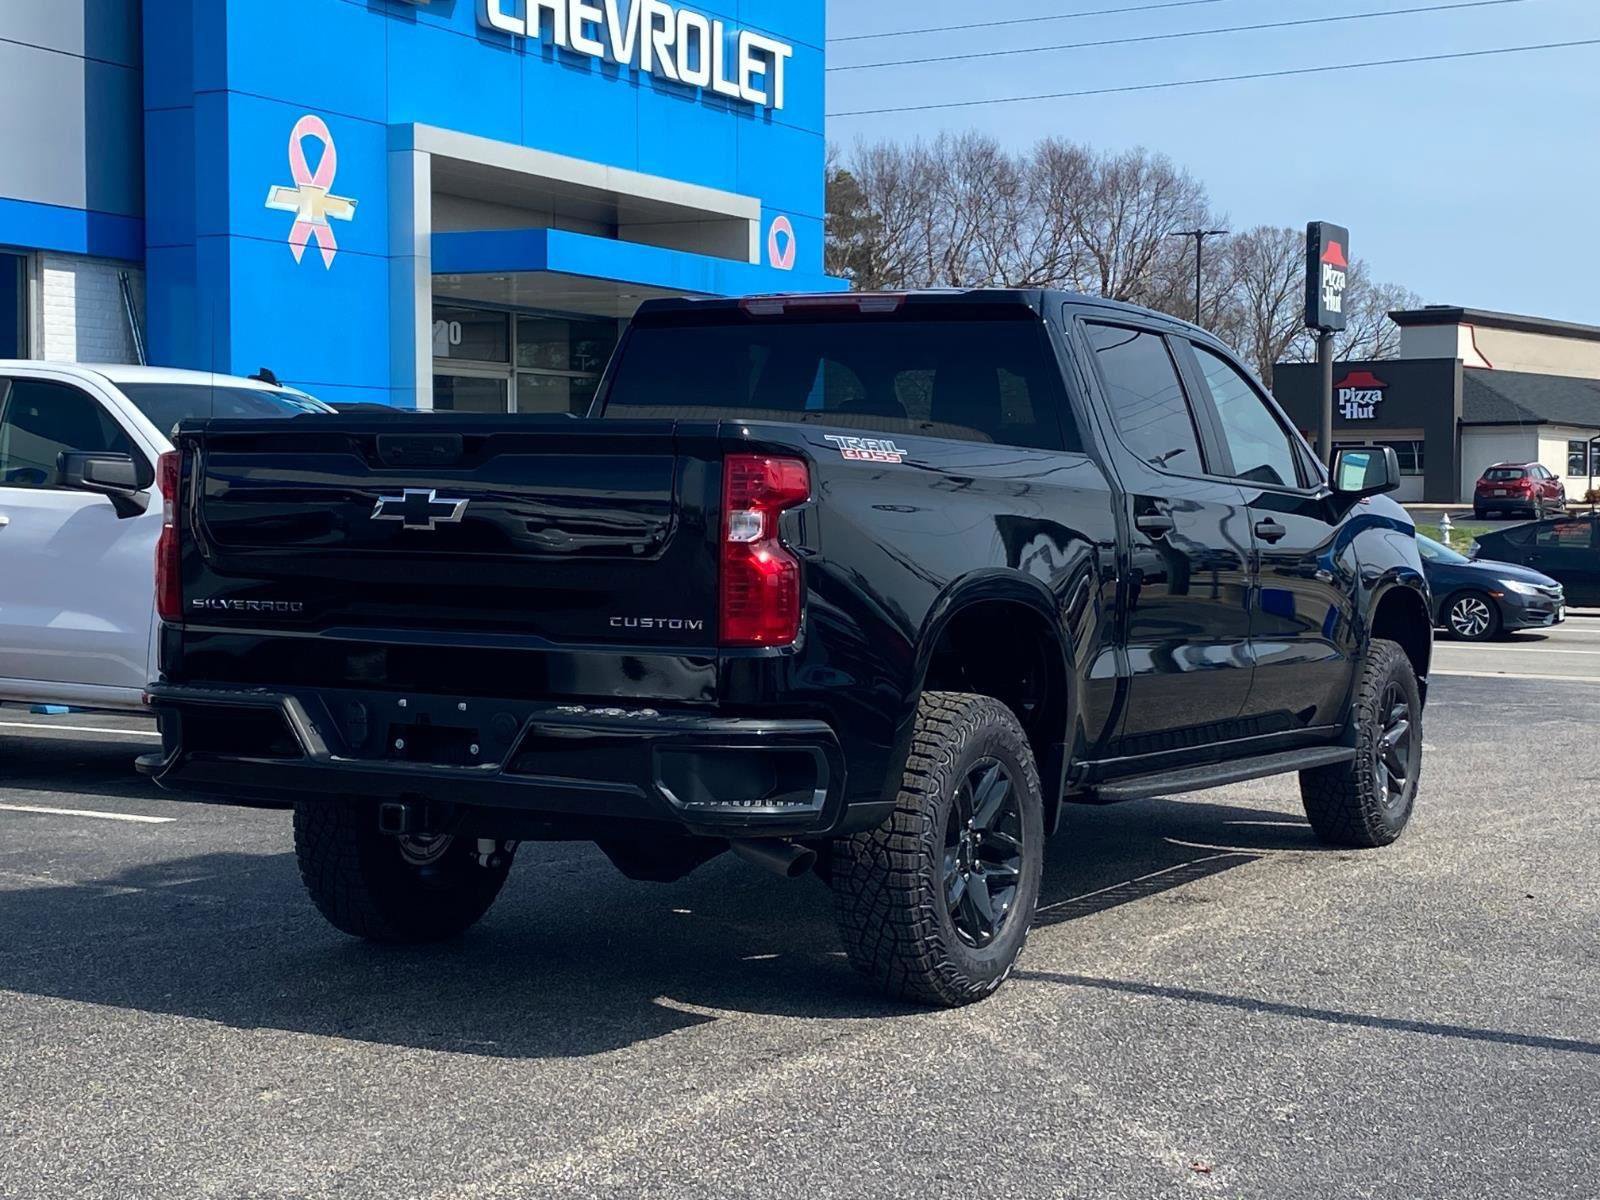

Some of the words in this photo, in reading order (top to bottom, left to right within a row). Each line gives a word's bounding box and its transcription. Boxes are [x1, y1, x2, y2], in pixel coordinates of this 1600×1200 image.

[1322, 264, 1346, 291] Pizza
[1322, 287, 1342, 313] Hut
[1338, 388, 1382, 406] Pizza
[1339, 402, 1375, 420] Hut
[824, 434, 908, 455] TRAIL
[841, 448, 902, 464] BOSS
[192, 598, 303, 612] SILVERADO
[609, 616, 703, 630] CUSTOM
